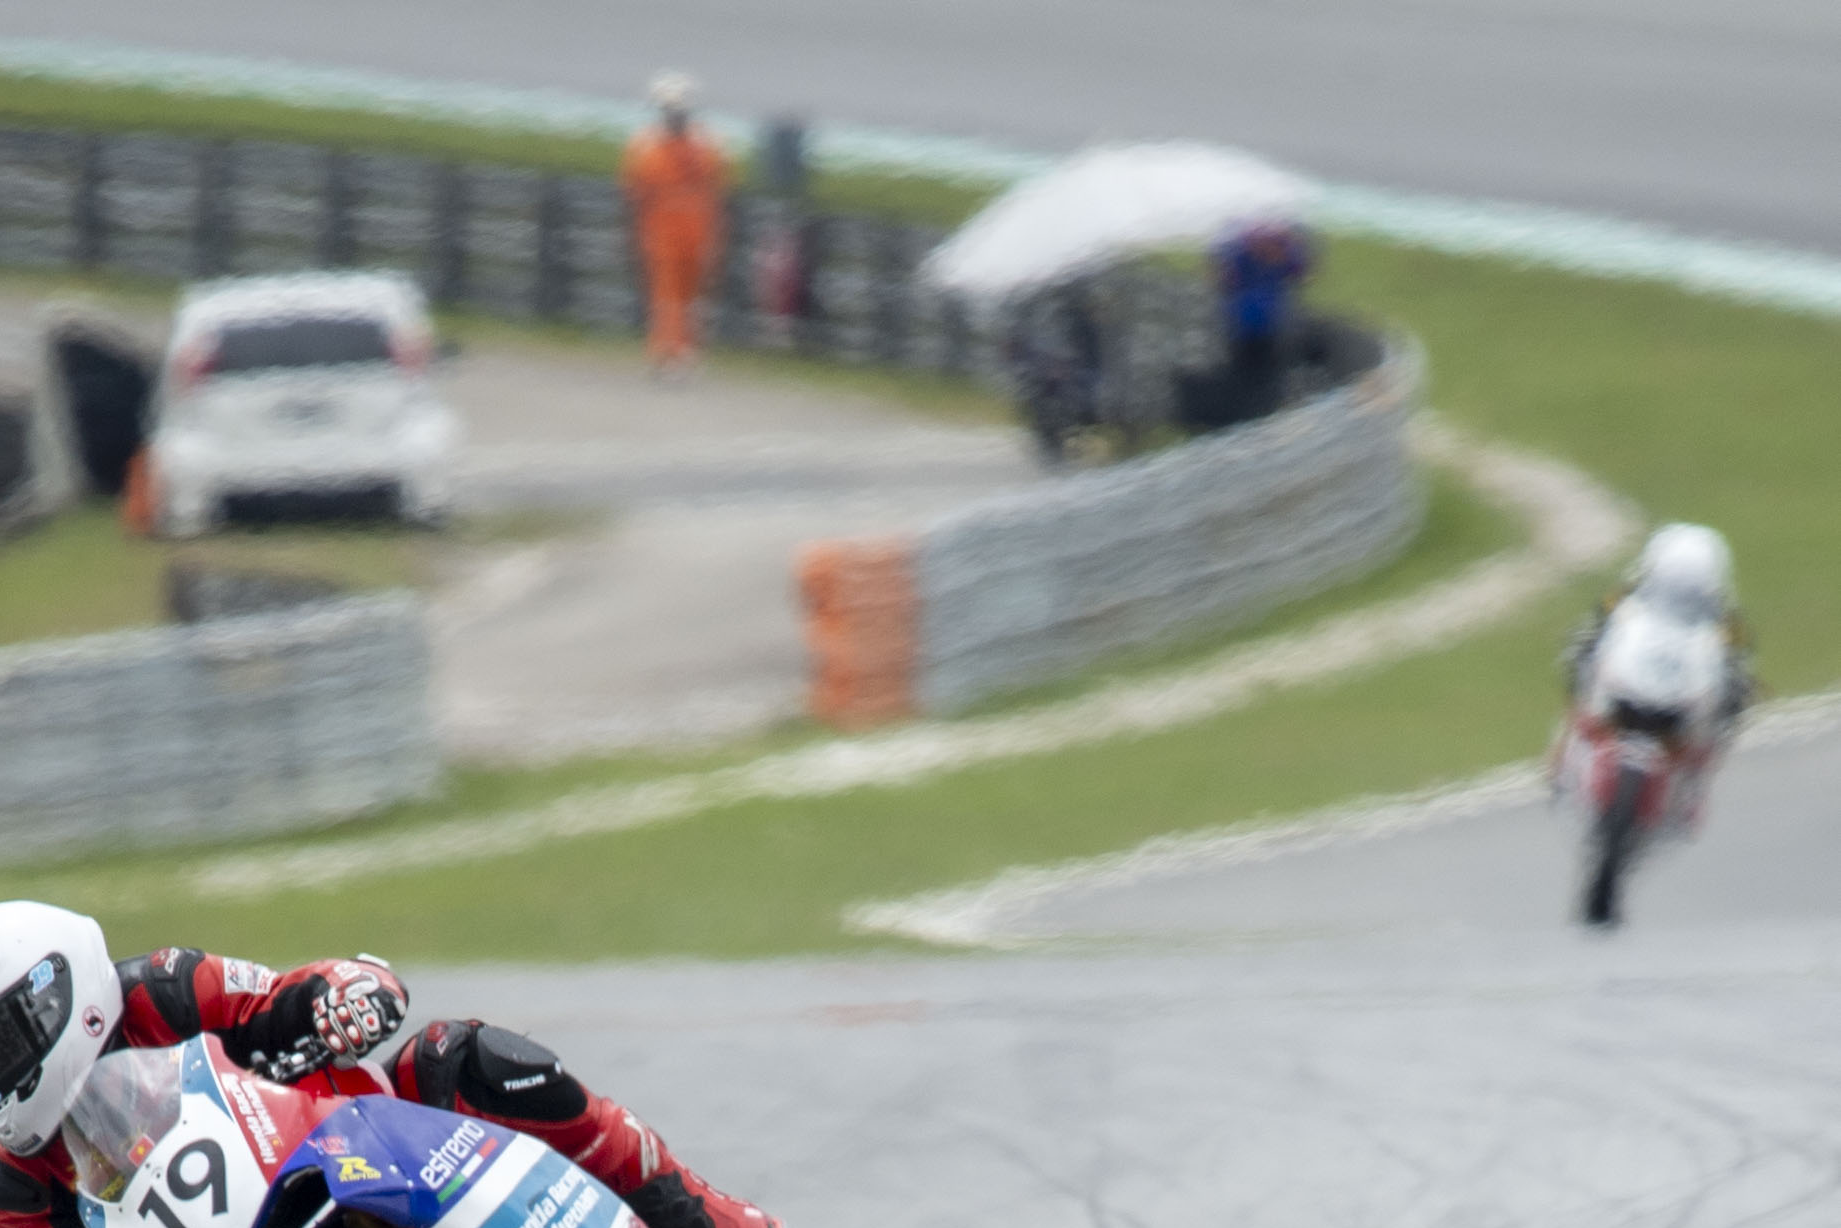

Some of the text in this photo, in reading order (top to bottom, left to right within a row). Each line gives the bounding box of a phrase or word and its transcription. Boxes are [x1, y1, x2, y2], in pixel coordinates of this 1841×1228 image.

[30, 960, 55, 994] 19
[245, 1115, 278, 1164] Honda
[419, 1119, 486, 1190] estremo
